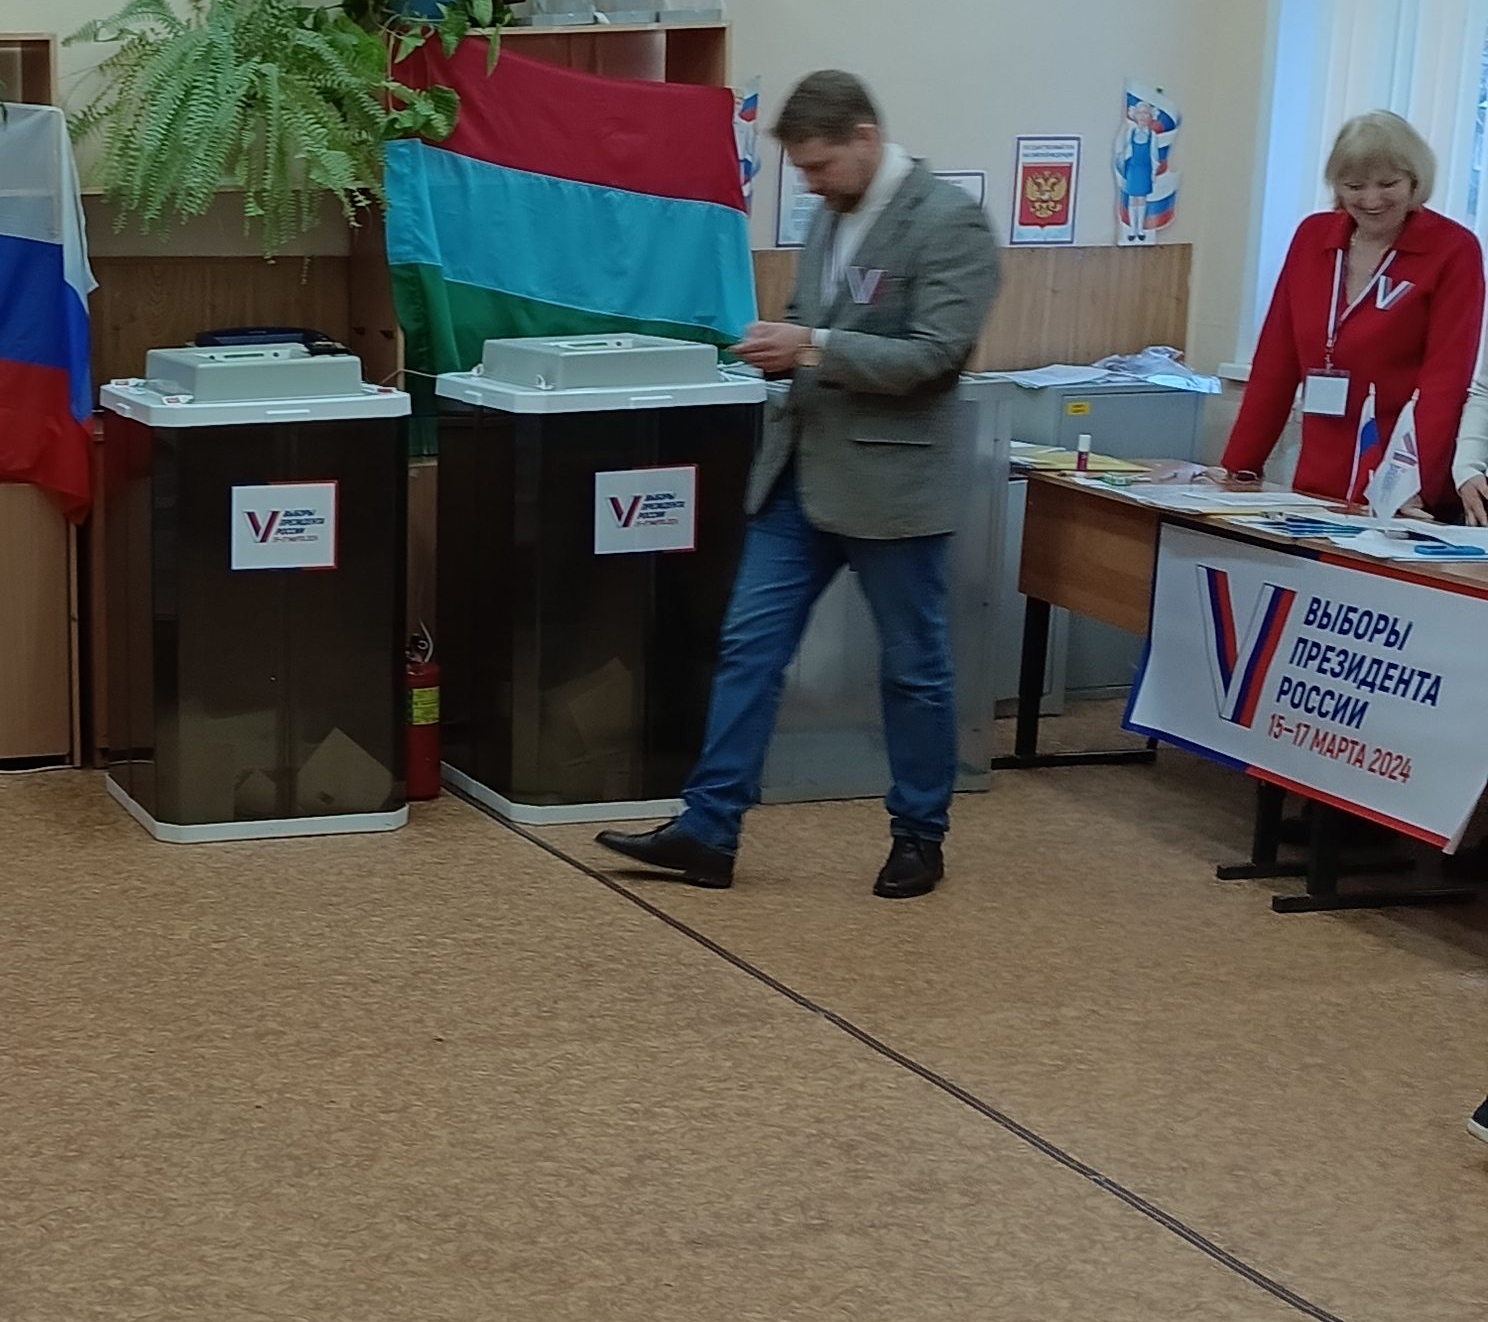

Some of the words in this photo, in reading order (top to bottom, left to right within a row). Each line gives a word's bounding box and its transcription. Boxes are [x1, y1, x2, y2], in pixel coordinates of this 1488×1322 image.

[1303, 596, 1413, 651] ВЫБОРЫ
[1289, 637, 1443, 707] ПРЕЗИДЕНТА
[1276, 675, 1369, 729] РОССИИ
[1310, 728, 1367, 769] МАРТА
[1367, 748, 1413, 783] 2024
